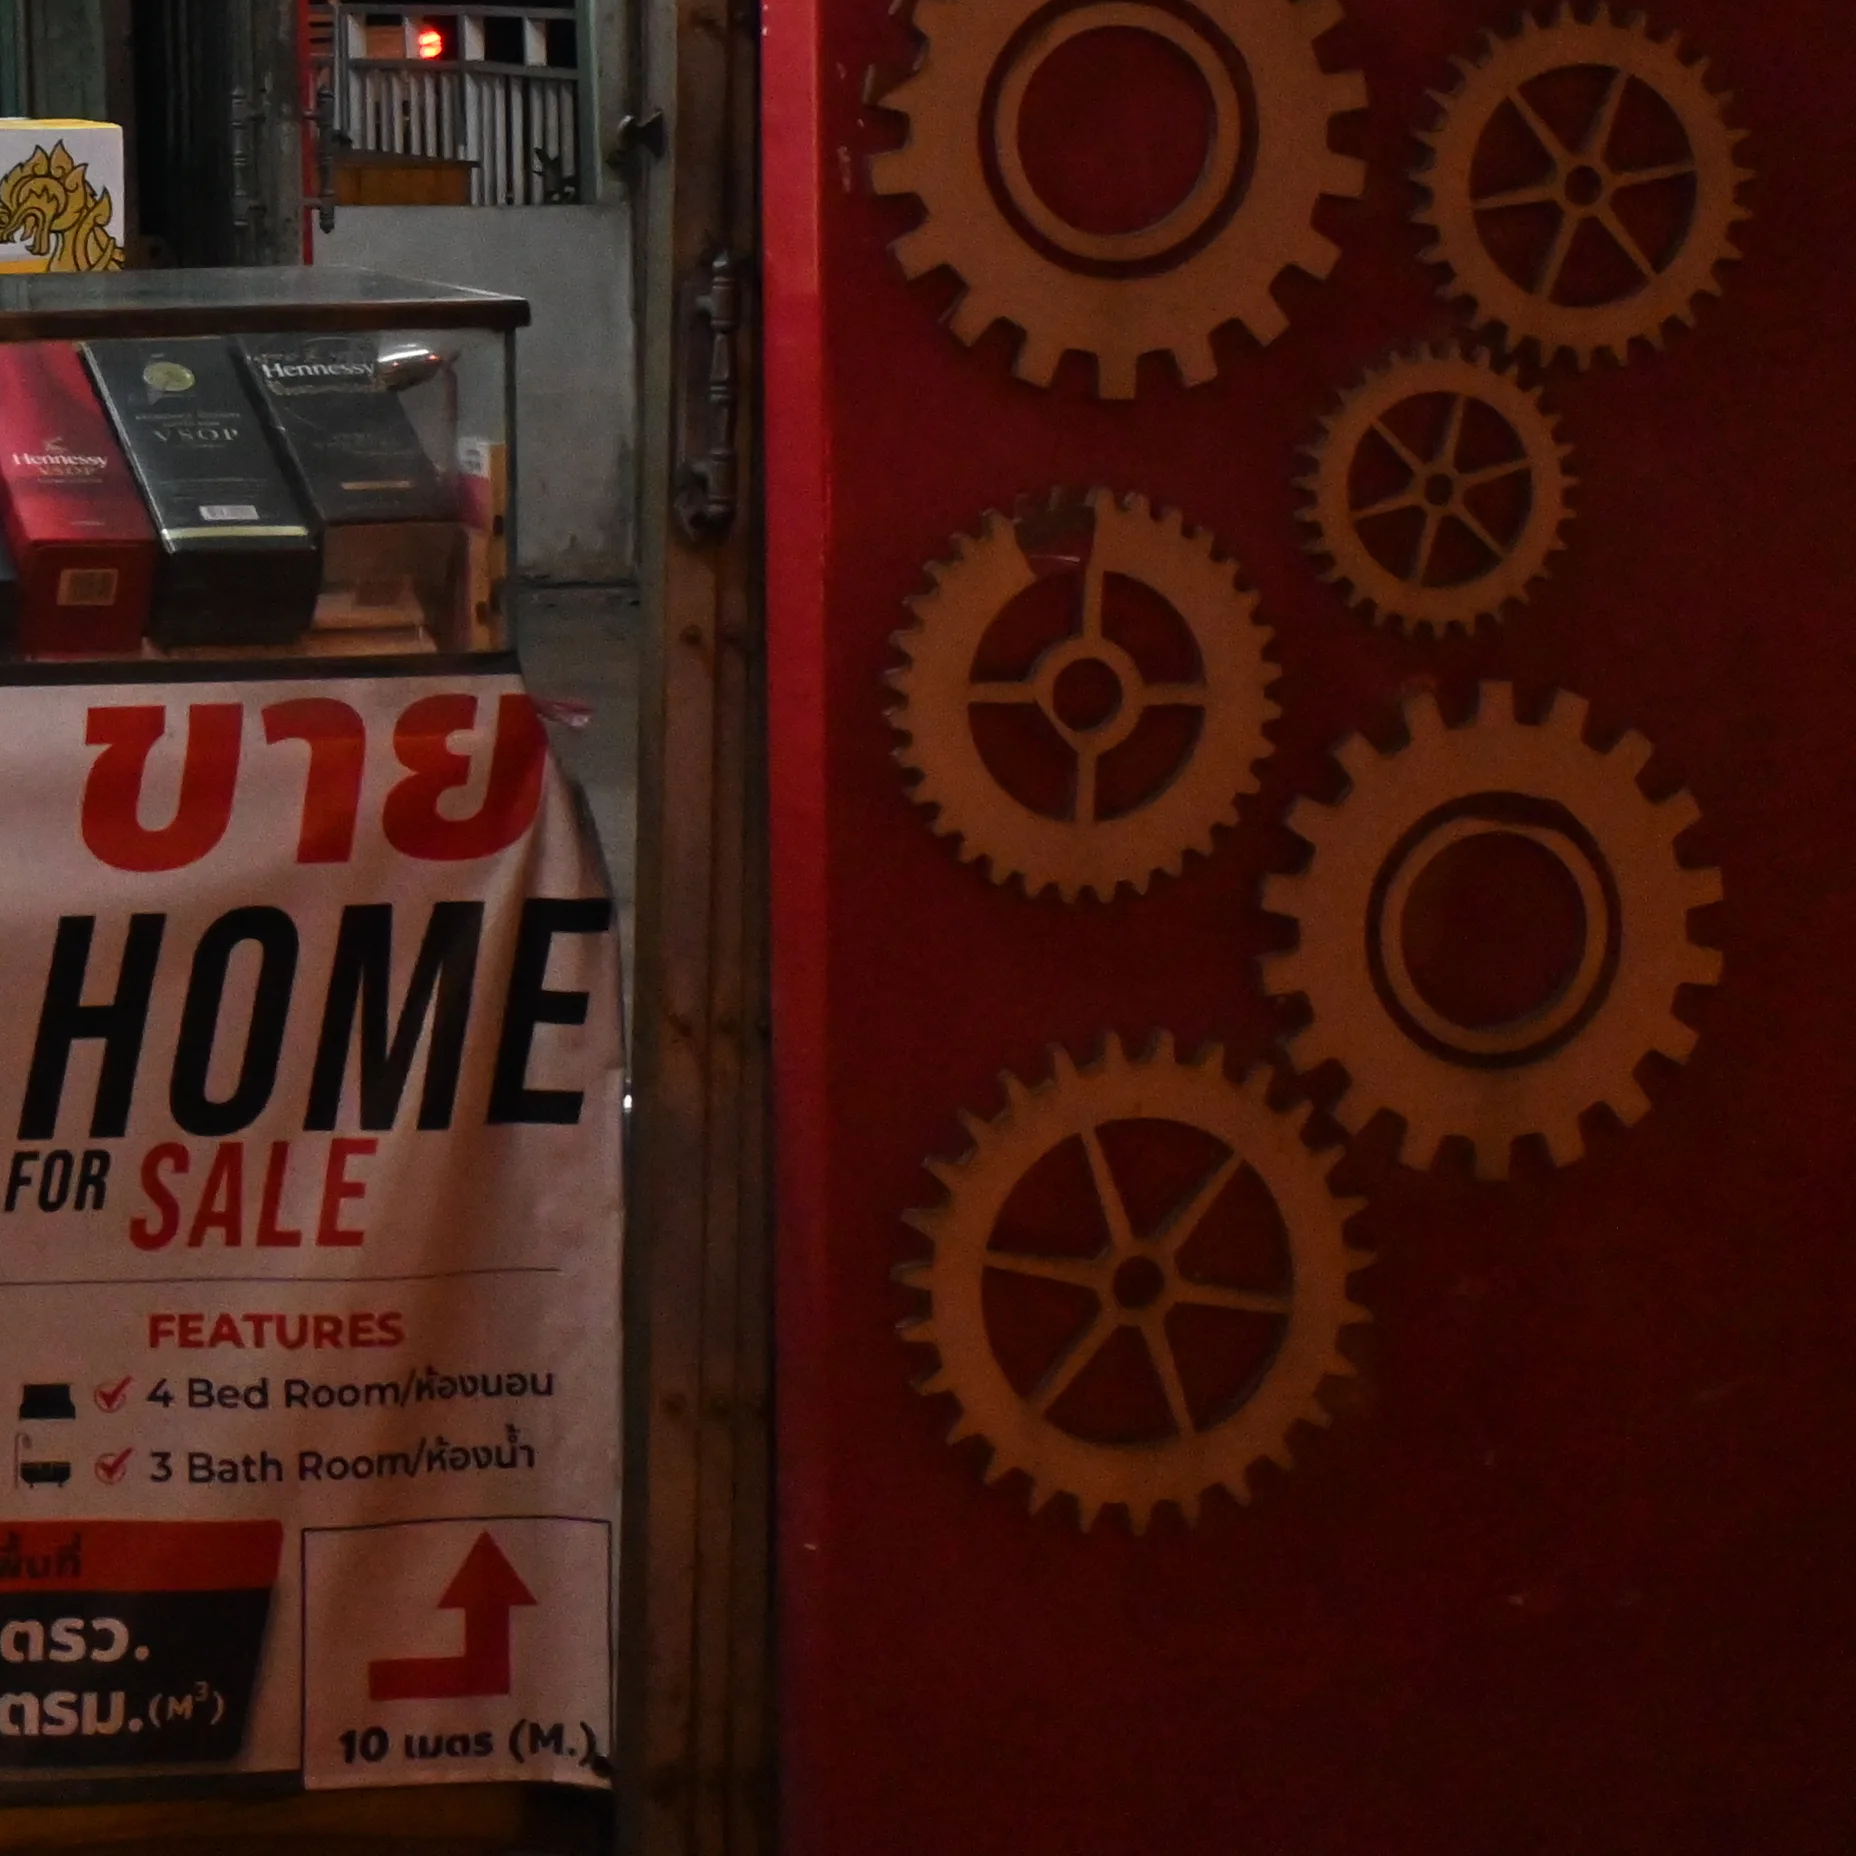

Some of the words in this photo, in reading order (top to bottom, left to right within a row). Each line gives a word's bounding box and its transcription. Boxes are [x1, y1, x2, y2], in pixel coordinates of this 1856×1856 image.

[261, 358, 375, 381] Hennessy
[12, 452, 109, 471] Hennessy
[81, 692, 550, 873] ขาย
[17, 897, 612, 1141] HOME
[2, 1149, 111, 1214] FOR
[128, 1137, 380, 1252] SALE
[148, 1311, 406, 1350] FEATURES
[146, 1377, 174, 1408] 4
[189, 1377, 269, 1411] Bed
[150, 1451, 173, 1484] 3
[189, 1448, 284, 1485] Bath
[0, 1613, 152, 1663] ตรว.
[338, 1726, 390, 1764] 10
[403, 1730, 495, 1761] เมตร
[508, 1721, 599, 1768] (M.)
